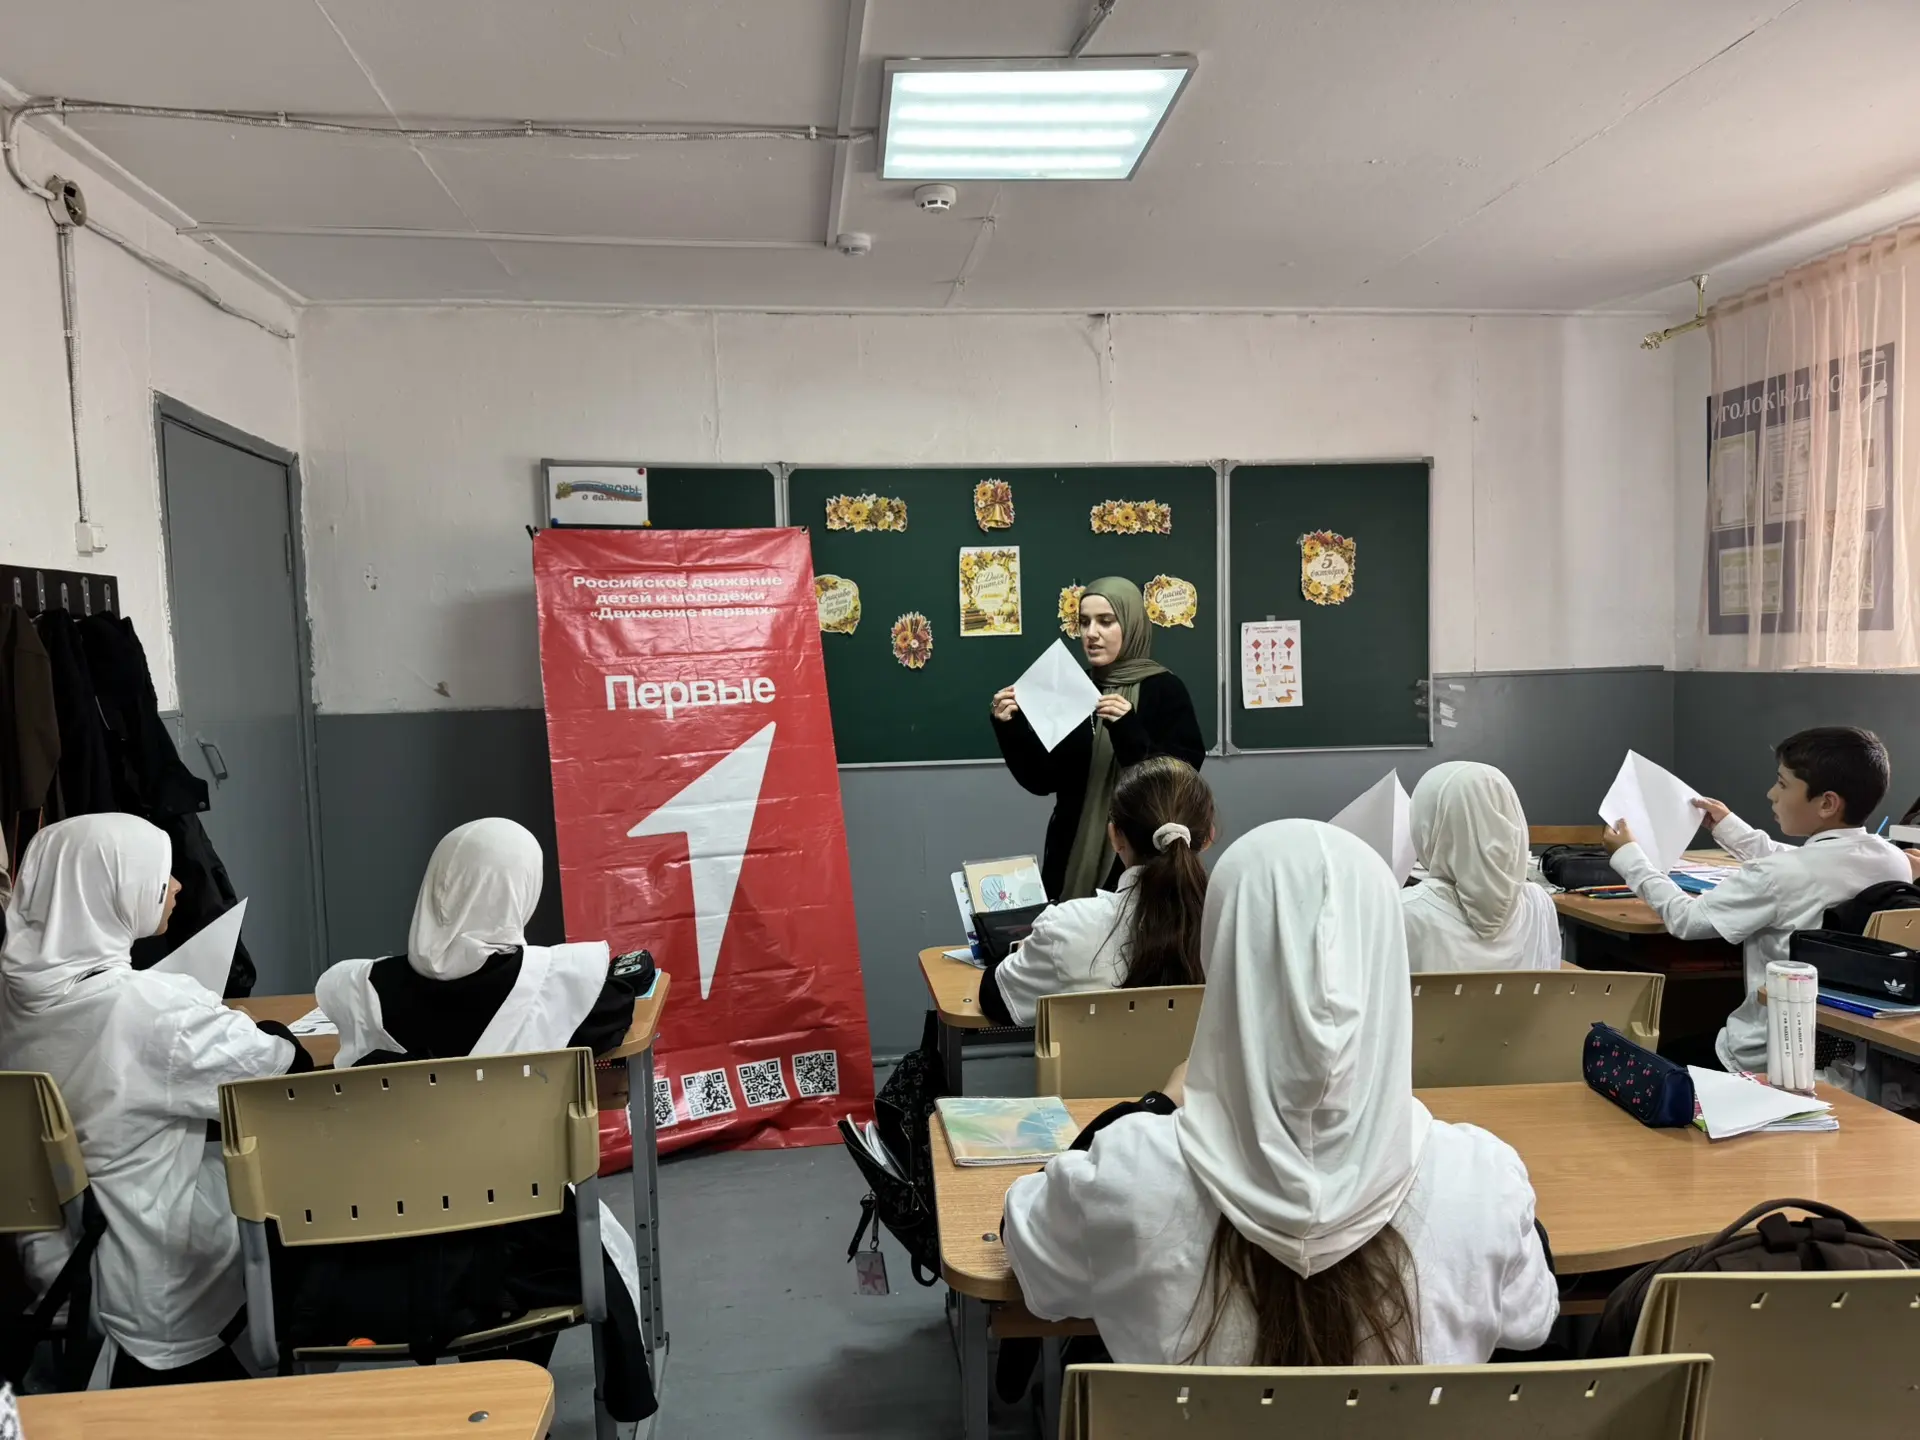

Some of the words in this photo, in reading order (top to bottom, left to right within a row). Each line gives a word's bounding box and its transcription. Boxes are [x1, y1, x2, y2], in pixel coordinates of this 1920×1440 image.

[1321, 554, 1334, 569] 5
[573, 576, 687, 588] Российское
[692, 576, 783, 588] движение
[596, 592, 651, 604] детей
[656, 594, 666, 602] и
[590, 608, 698, 620] «Движение
[701, 606, 778, 617] первых»
[605, 675, 776, 719] Первые
